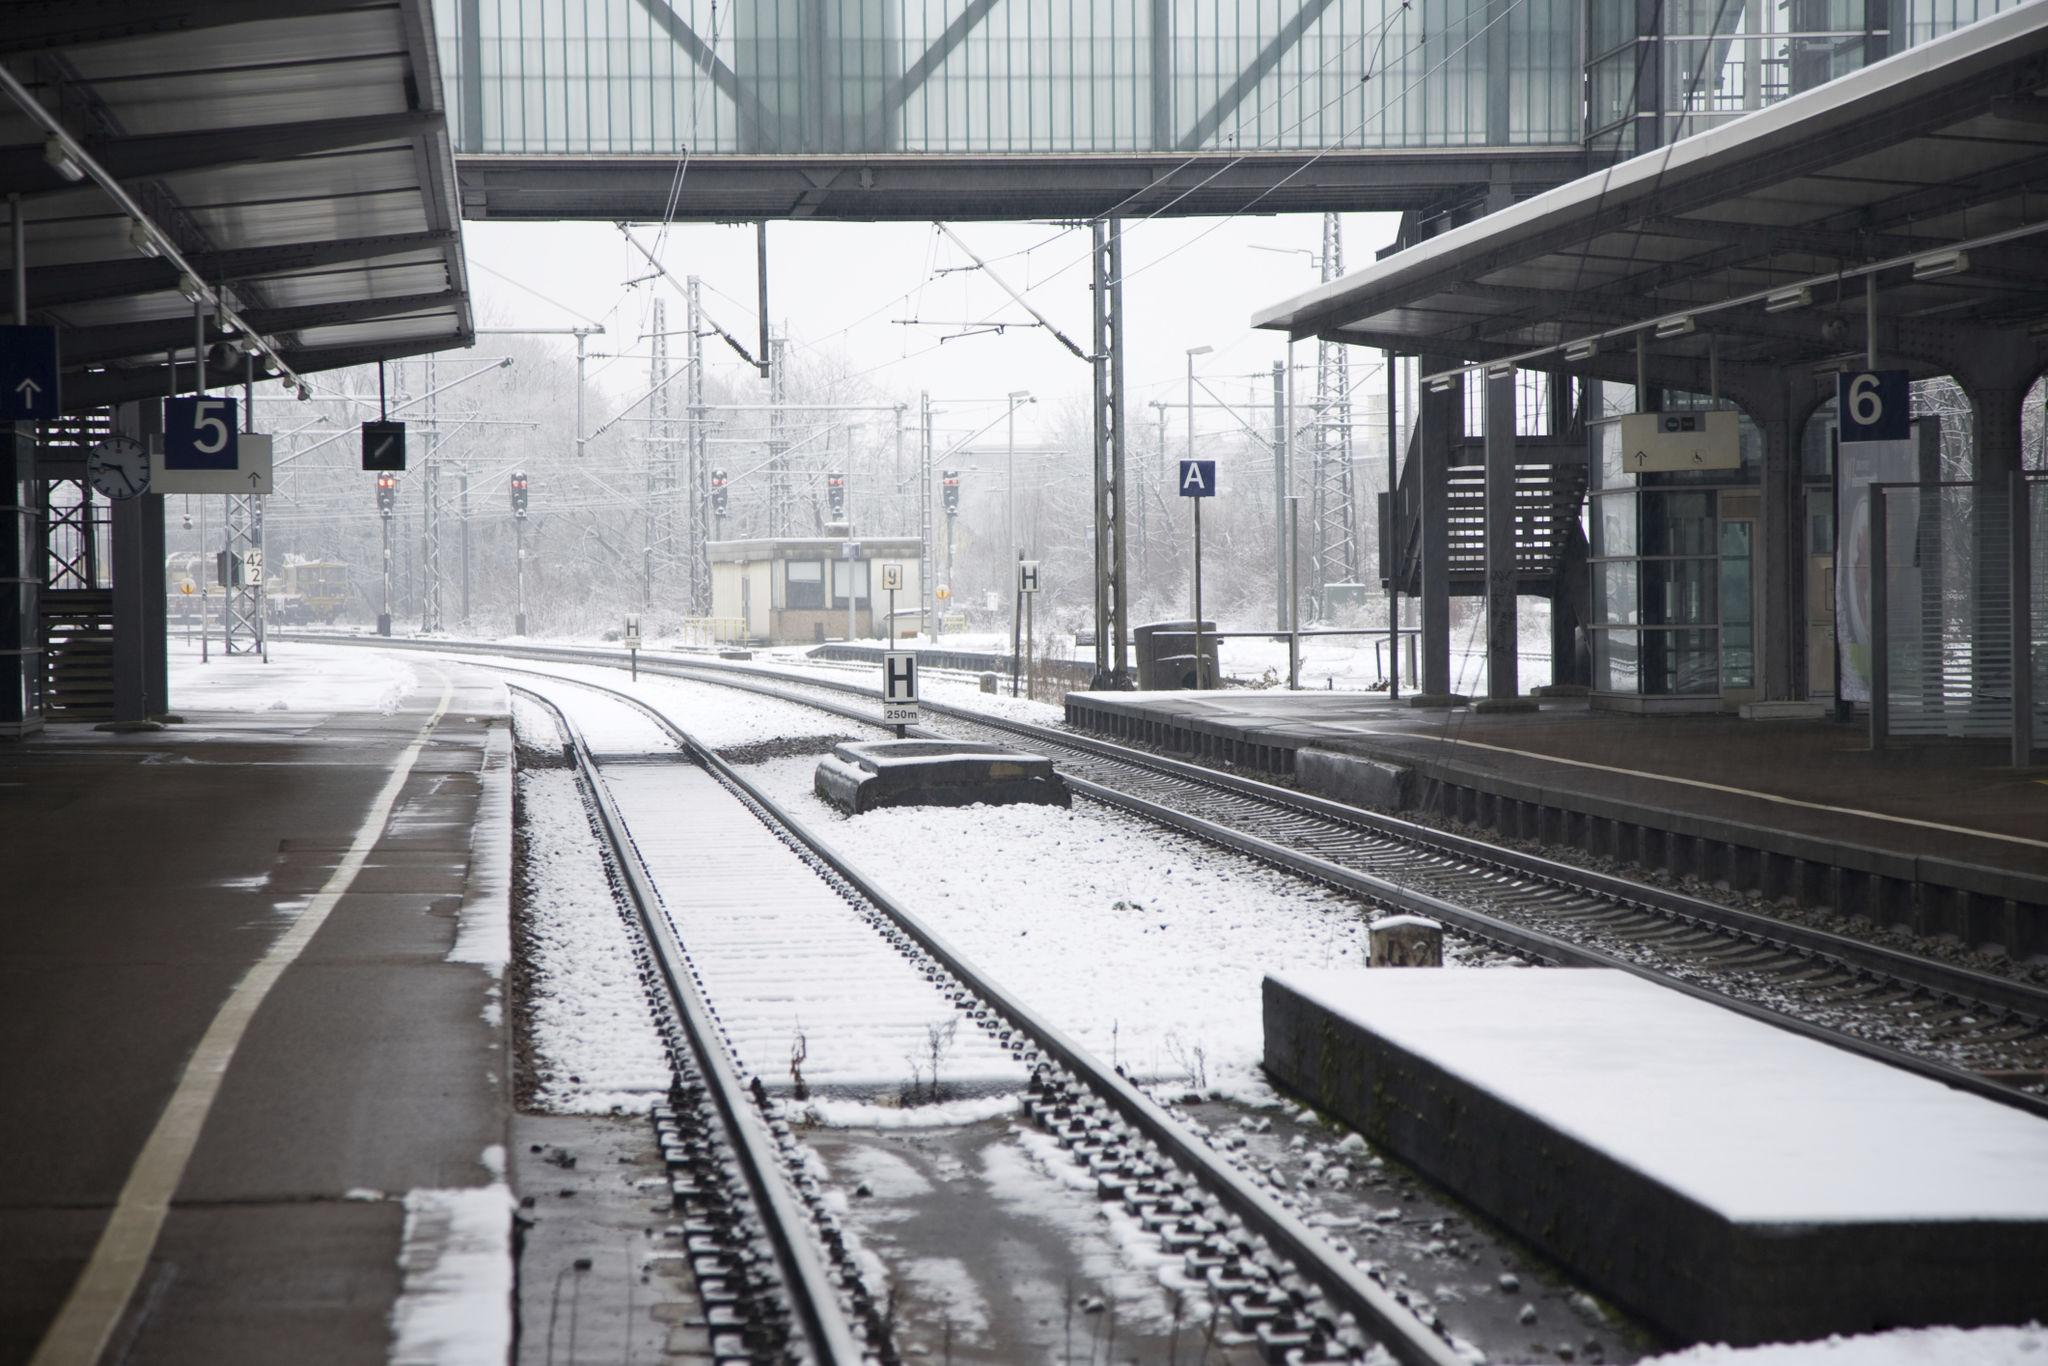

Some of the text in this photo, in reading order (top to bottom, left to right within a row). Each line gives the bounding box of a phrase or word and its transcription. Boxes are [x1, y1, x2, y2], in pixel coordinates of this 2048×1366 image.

[1849, 374, 1882, 425] 6
[193, 401, 228, 453] 5
[1183, 462, 1205, 489] A
[246, 552, 263, 567] 42
[251, 568, 261, 582] 2
[888, 567, 896, 585] 9
[1022, 565, 1037, 590] H
[627, 617, 639, 636] H
[888, 658, 914, 698] H
[886, 709, 918, 719] 250m
